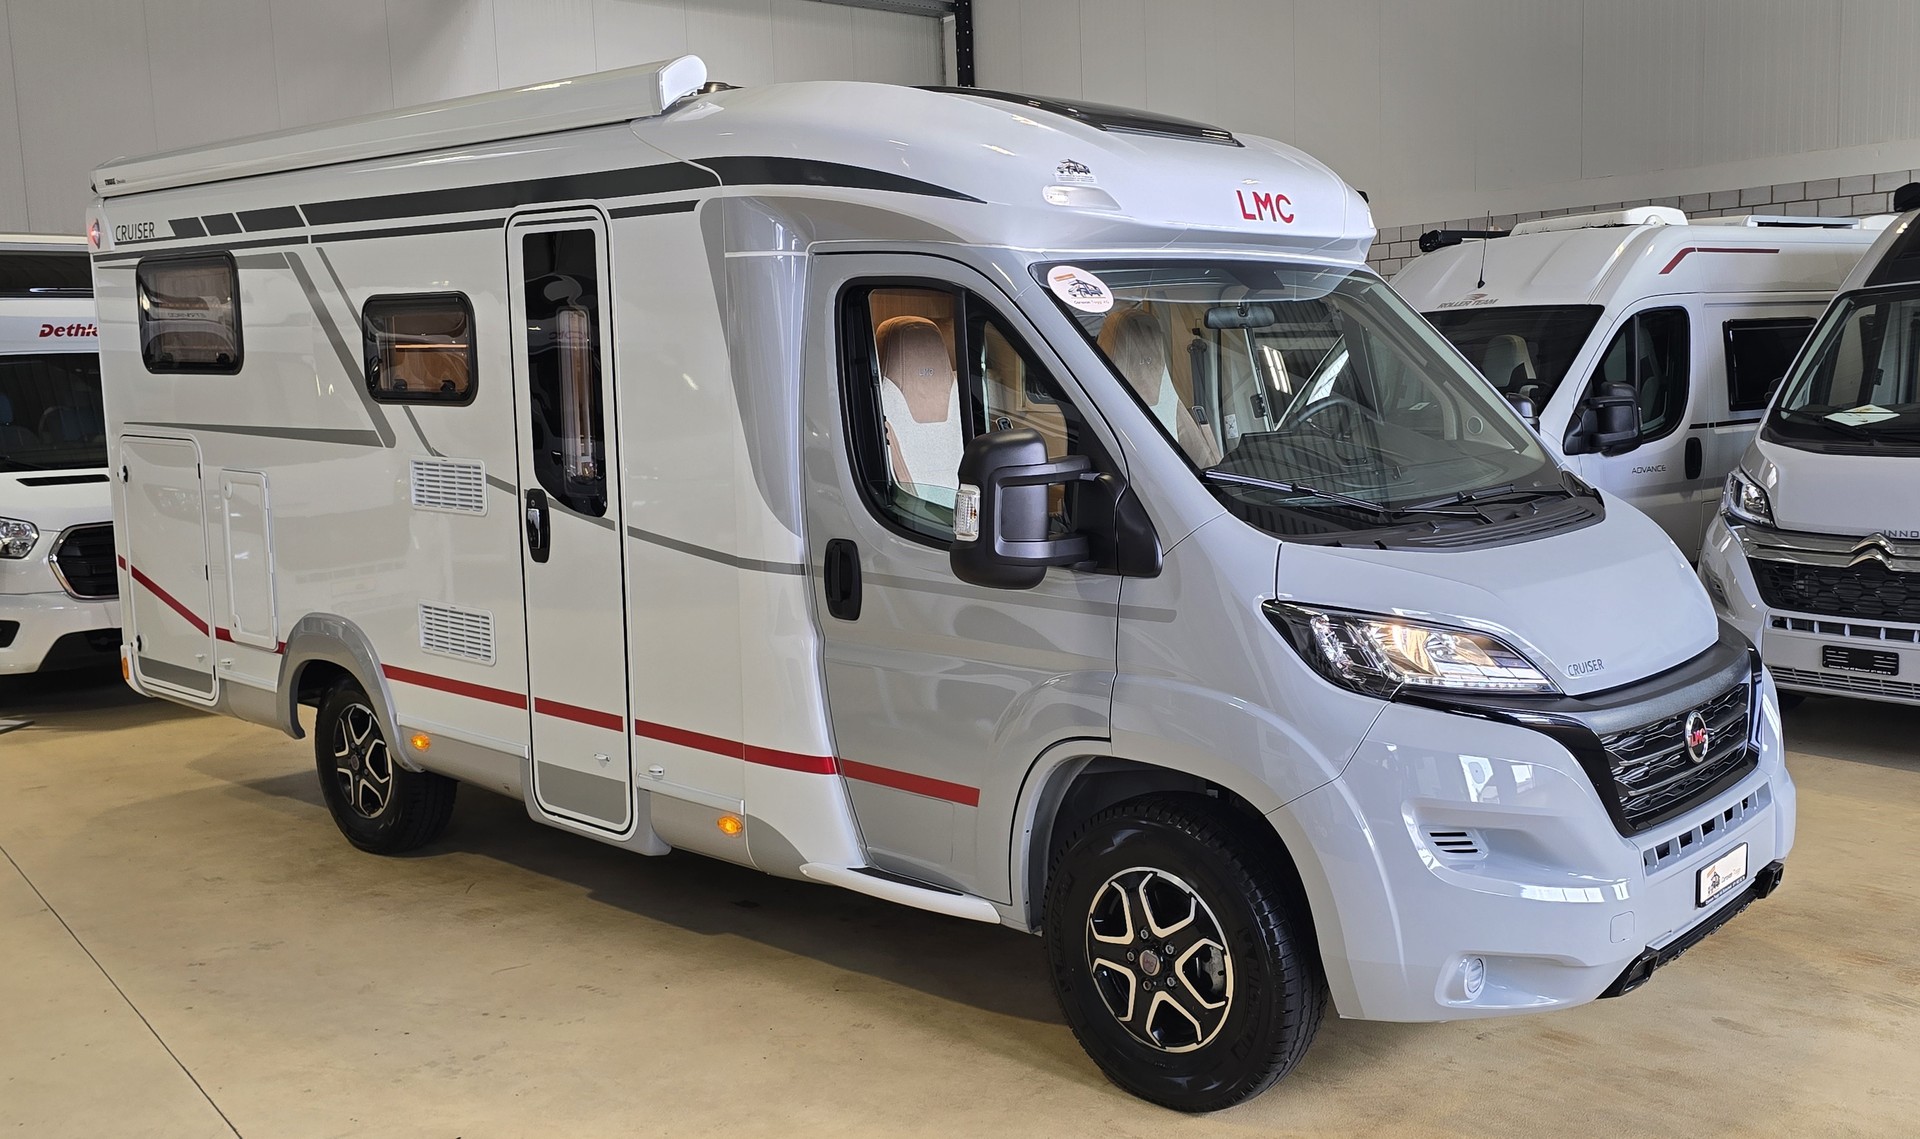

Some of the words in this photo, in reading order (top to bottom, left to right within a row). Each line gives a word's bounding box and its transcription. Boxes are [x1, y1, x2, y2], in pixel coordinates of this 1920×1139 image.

[1236, 189, 1294, 223] LMC
[115, 222, 155, 241] CRUISER
[1631, 464, 1667, 474] ADVANCE
[1883, 529, 1920, 538] INNO
[1567, 658, 1605, 676] CRUISER
[1689, 727, 1706, 747] LMC
